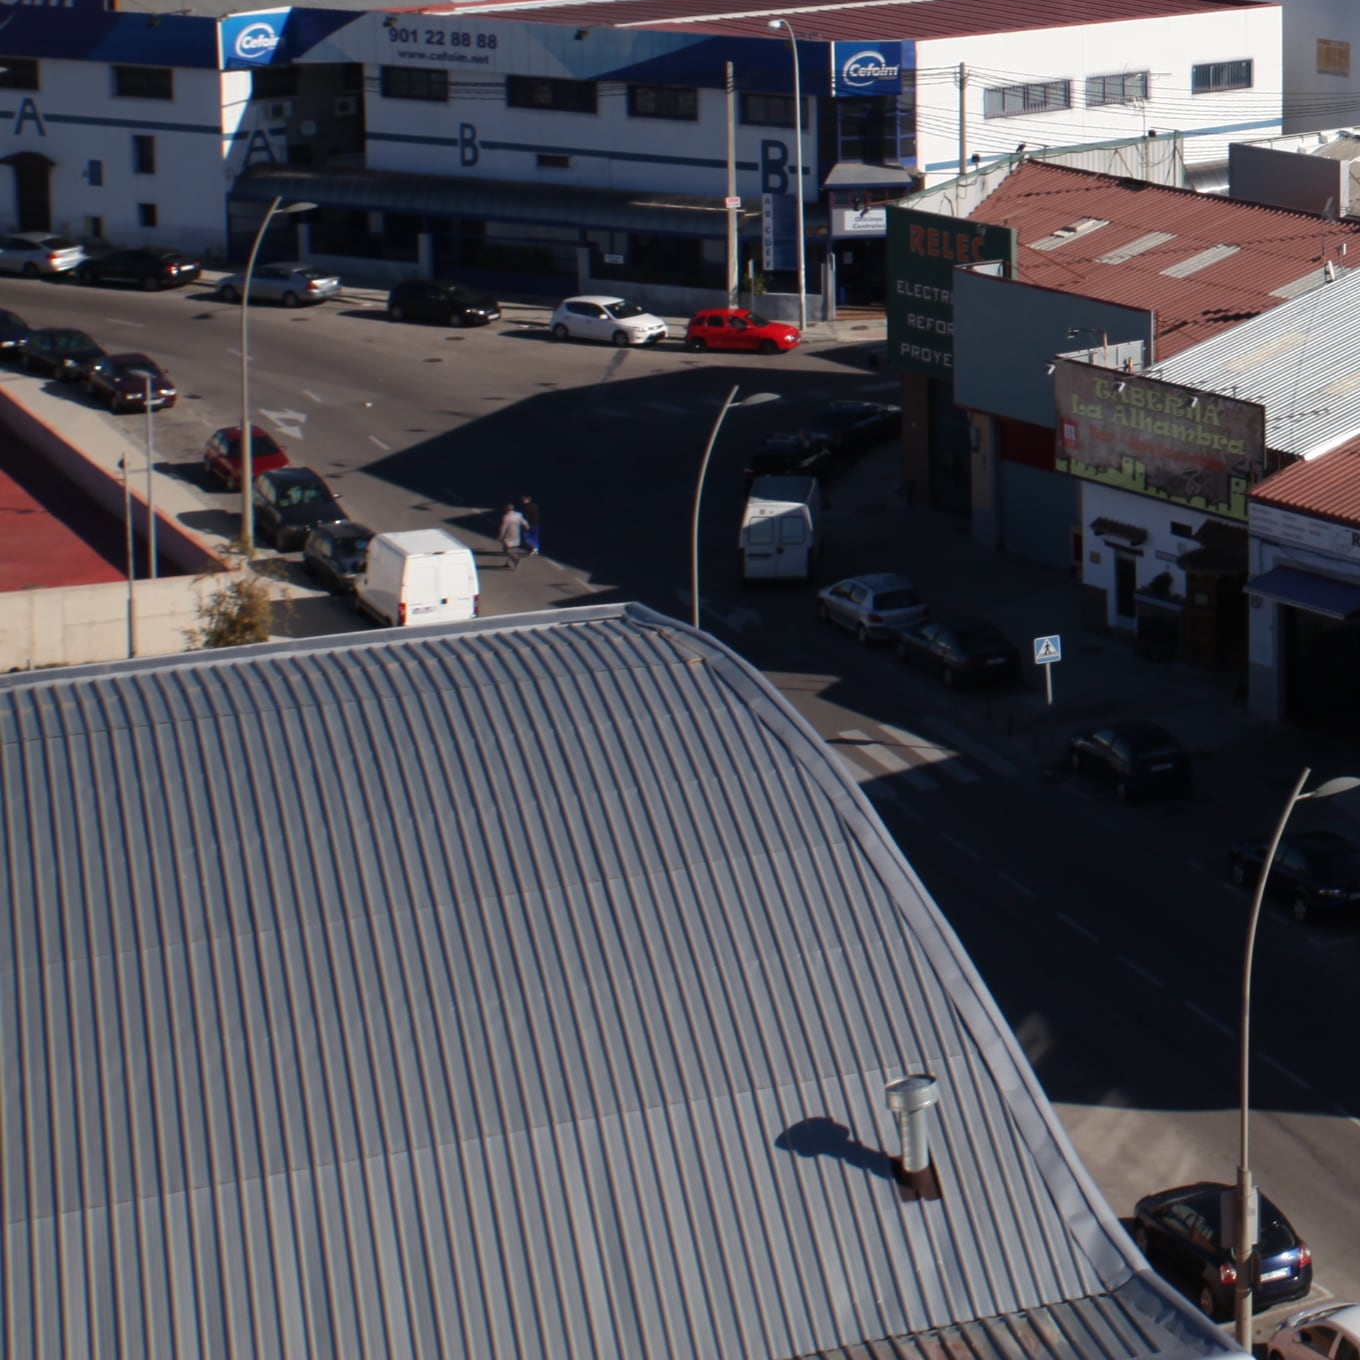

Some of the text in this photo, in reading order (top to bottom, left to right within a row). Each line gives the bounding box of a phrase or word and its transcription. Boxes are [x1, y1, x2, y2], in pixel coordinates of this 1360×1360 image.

[389, 27, 497, 49] 901 22 88 88
[398, 50, 490, 64] www.cefoim.net
[849, 63, 899, 77] Cefoim
[15, 97, 46, 137] A
[459, 123, 479, 167] B
[761, 140, 790, 193] B
[909, 224, 985, 262] RELEC
[900, 342, 953, 367] PROYE
[1112, 403, 1246, 455] Alhambra
